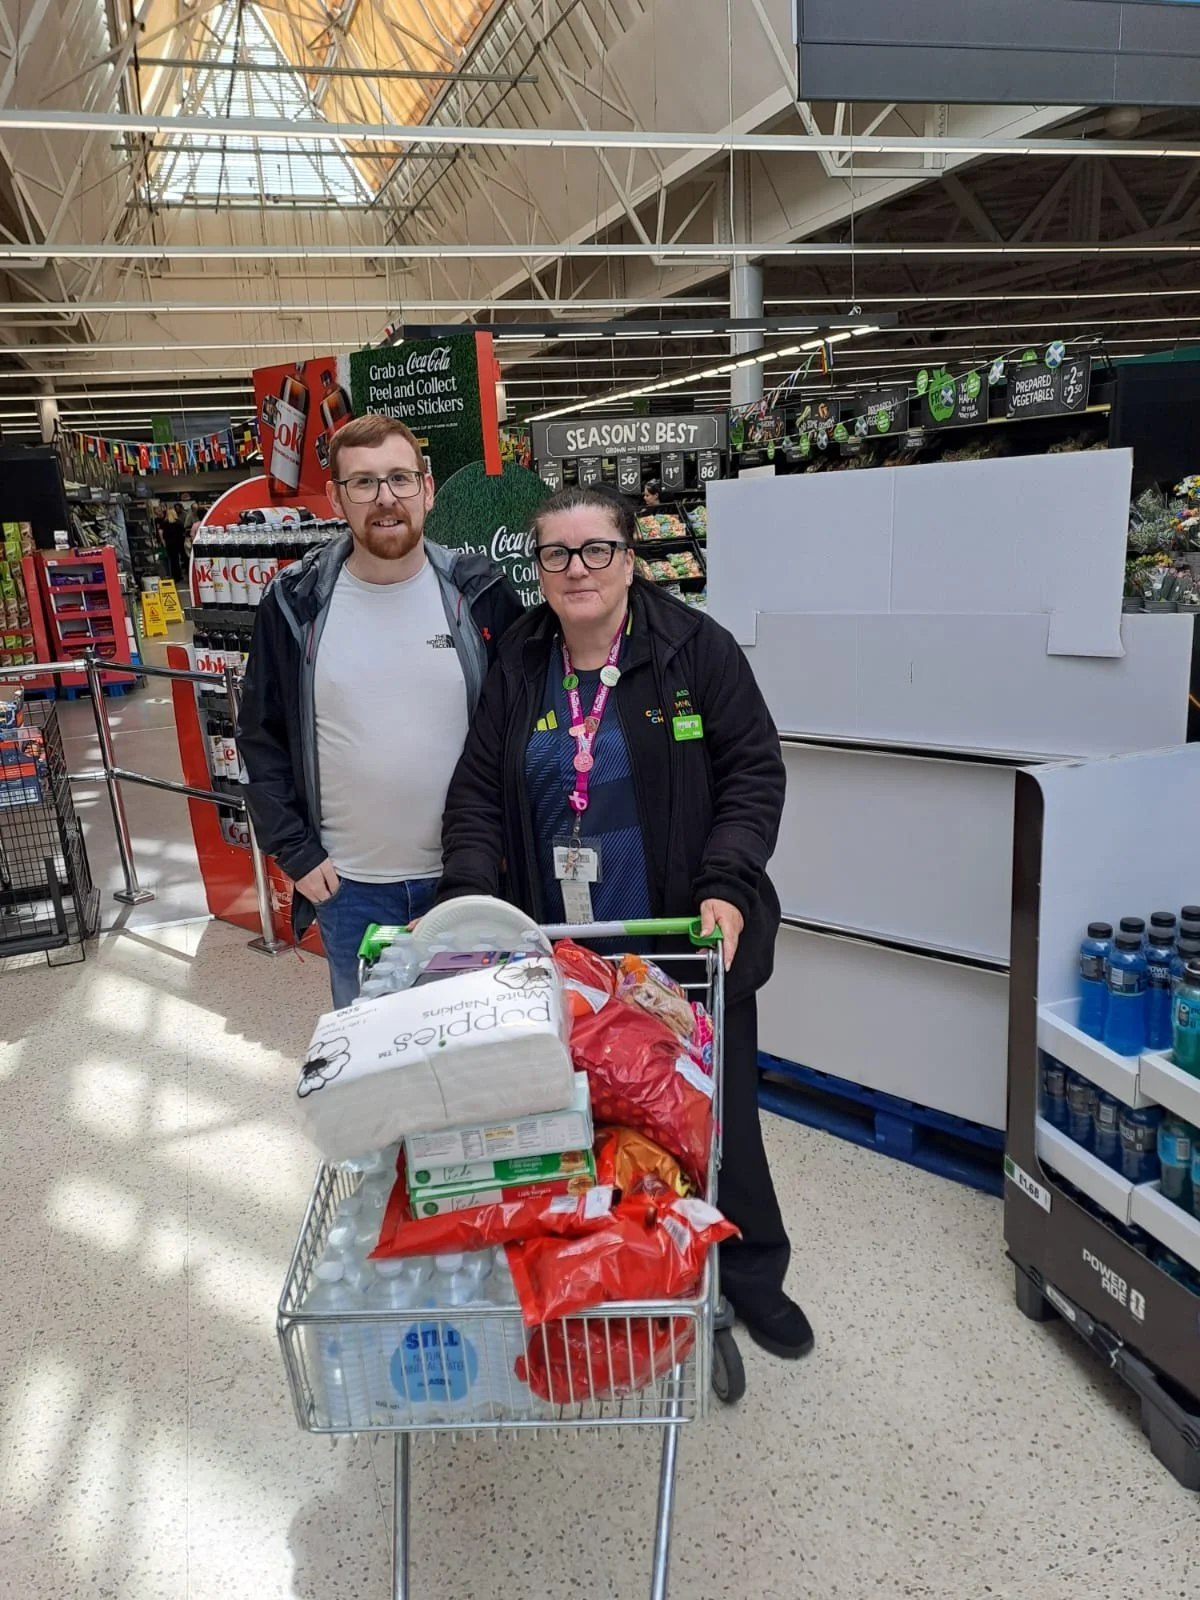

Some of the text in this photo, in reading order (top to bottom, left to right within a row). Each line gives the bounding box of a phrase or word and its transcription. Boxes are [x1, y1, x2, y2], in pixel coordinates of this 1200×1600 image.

[369, 362, 396, 381] Grab
[397, 364, 405, 377] a
[1070, 366, 1077, 385] 2
[369, 376, 457, 402] Peel and Collect
[1012, 375, 1054, 407] PREPARED VEGETABLES
[416, 397, 464, 416] Stickers
[566, 421, 699, 452] SEASON'S BEST
[422, 987, 551, 1019] White Napkins
[393, 1000, 552, 1052] poppies
[1082, 1248, 1128, 1293] POWER
[1101, 1276, 1127, 1308] ADE
